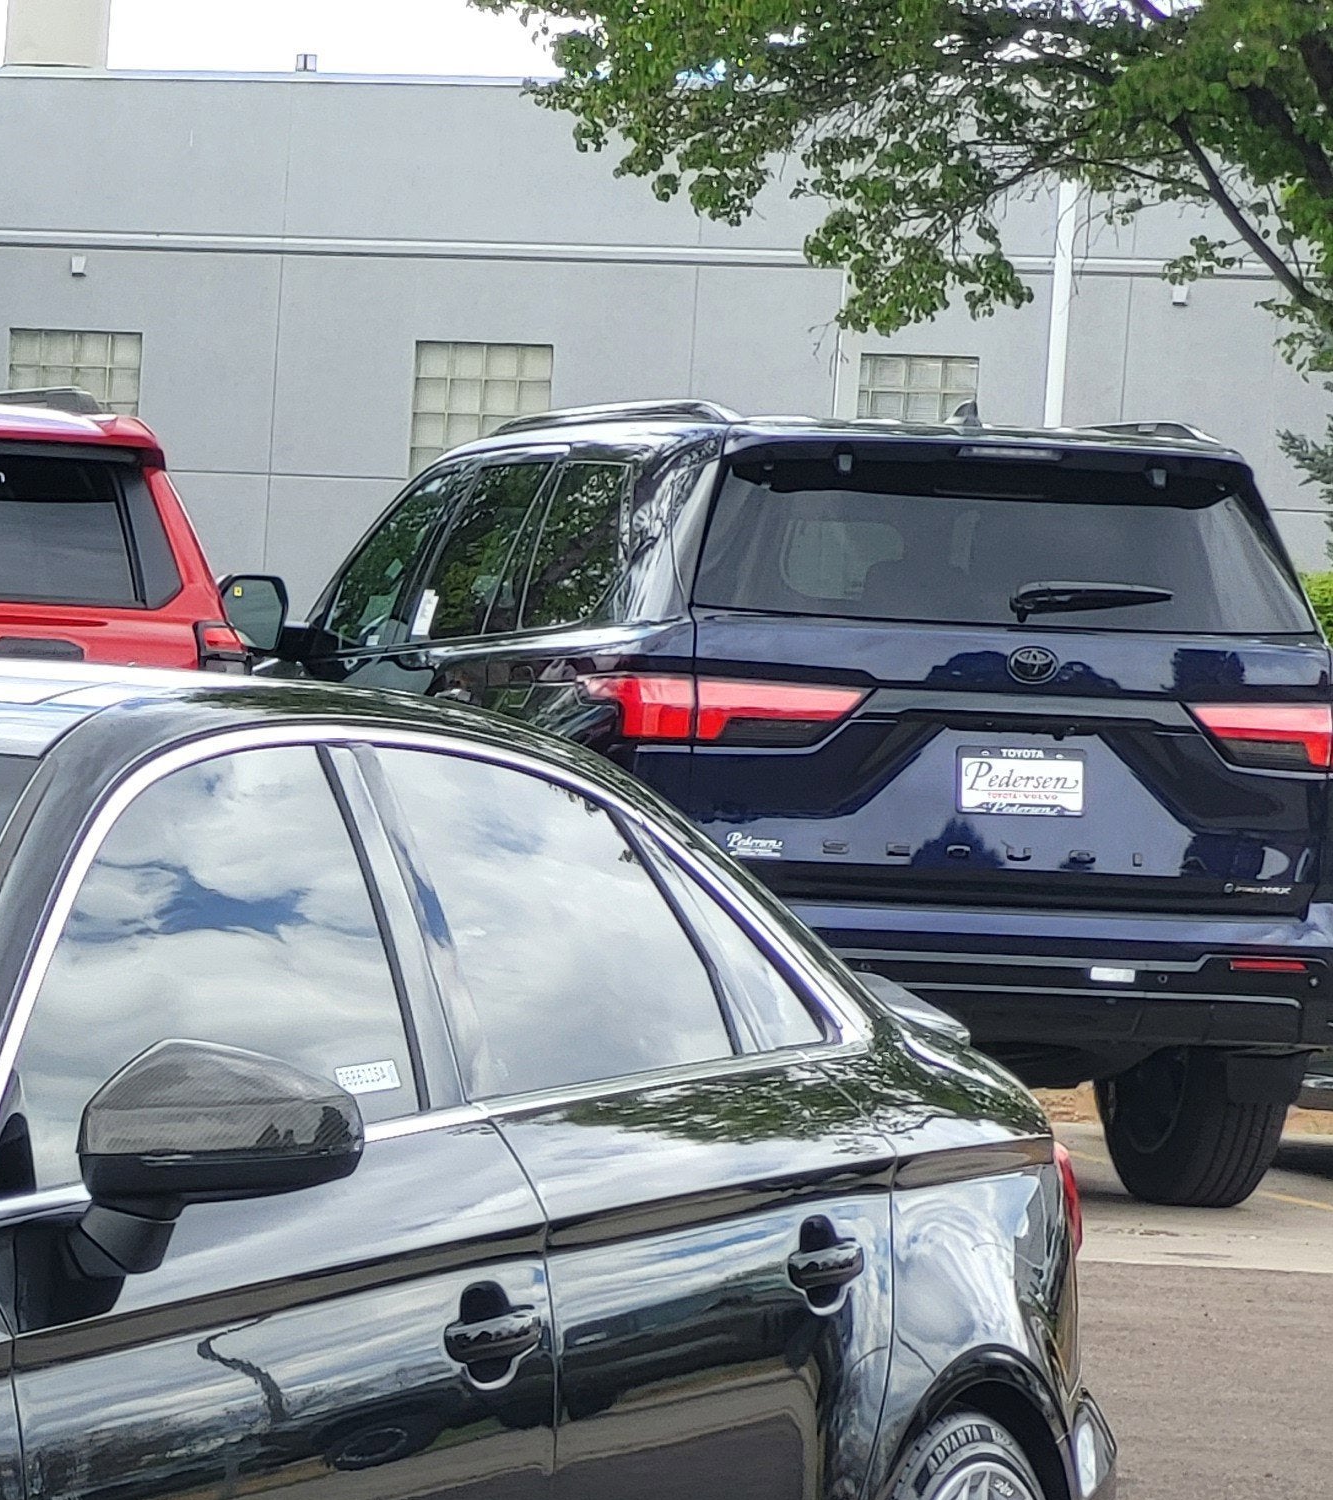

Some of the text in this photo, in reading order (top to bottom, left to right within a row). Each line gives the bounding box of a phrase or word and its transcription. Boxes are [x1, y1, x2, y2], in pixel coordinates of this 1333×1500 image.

[1000, 748, 1044, 759] TOYOTA
[964, 760, 1079, 791] Pedersen
[927, 1425, 982, 1477] ADVANTA
